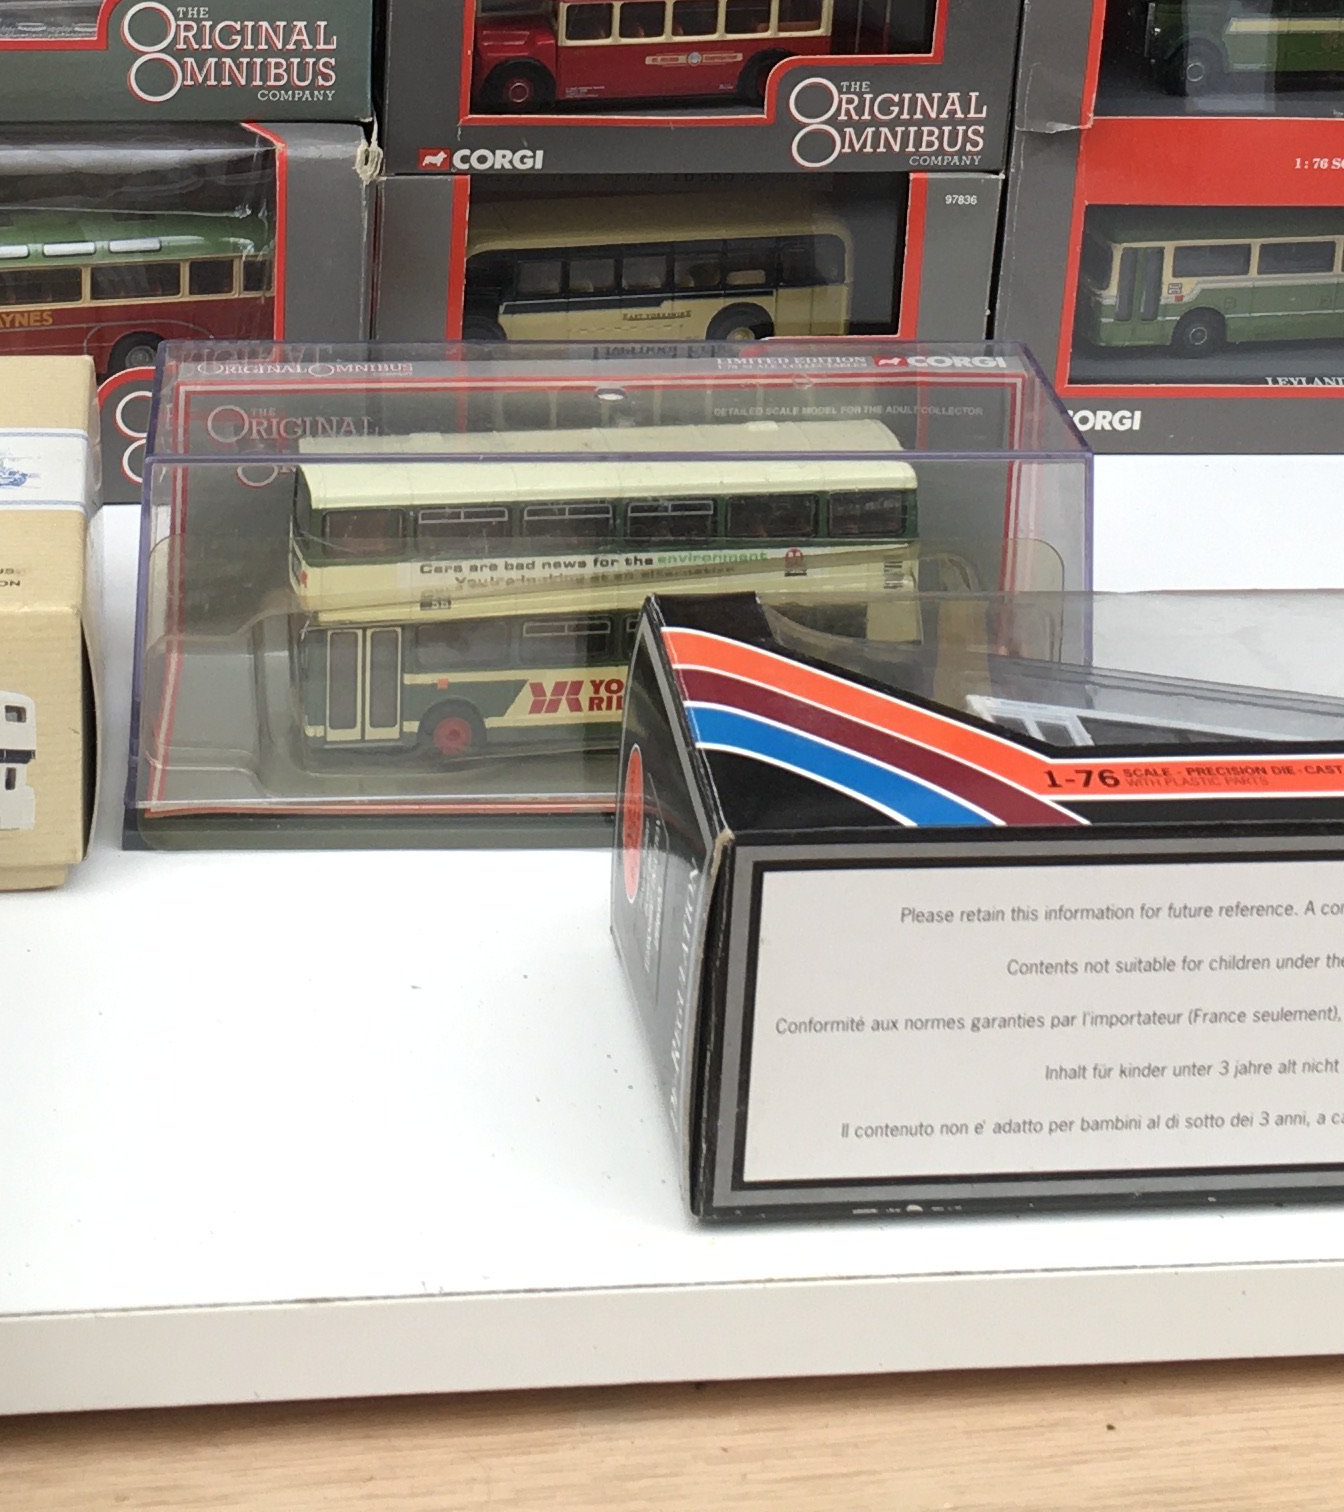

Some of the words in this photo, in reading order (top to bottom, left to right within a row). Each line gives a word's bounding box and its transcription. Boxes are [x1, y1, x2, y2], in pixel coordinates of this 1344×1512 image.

[177, 7, 209, 18] THE
[121, 2, 336, 52] ORIGINAL
[128, 52, 336, 103] OMNIBUS
[841, 82, 870, 91] THE
[257, 90, 335, 102] COMPANY
[789, 77, 987, 124] ORIGINAL
[792, 124, 984, 167] OMNIBUS
[452, 150, 544, 170] CORGI
[909, 155, 981, 166] COMPANY
[1313, 158, 1329, 170] 76
[945, 194, 977, 206] 97836
[908, 356, 1005, 368] CORGI
[420, 562, 463, 576] Cars
[469, 562, 498, 574] are
[503, 560, 536, 572] bad
[541, 560, 587, 571] news
[592, 557, 619, 569] for
[625, 555, 654, 568] the
[658, 550, 768, 565] environment
[901, 907, 954, 923] Please
[960, 906, 1005, 922] retain
[1011, 906, 1038, 921] this
[1045, 904, 1134, 921] information
[1140, 903, 1162, 919] for
[1168, 902, 1213, 918] future
[1219, 901, 1298, 917] reference.
[1304, 900, 1316, 915] A
